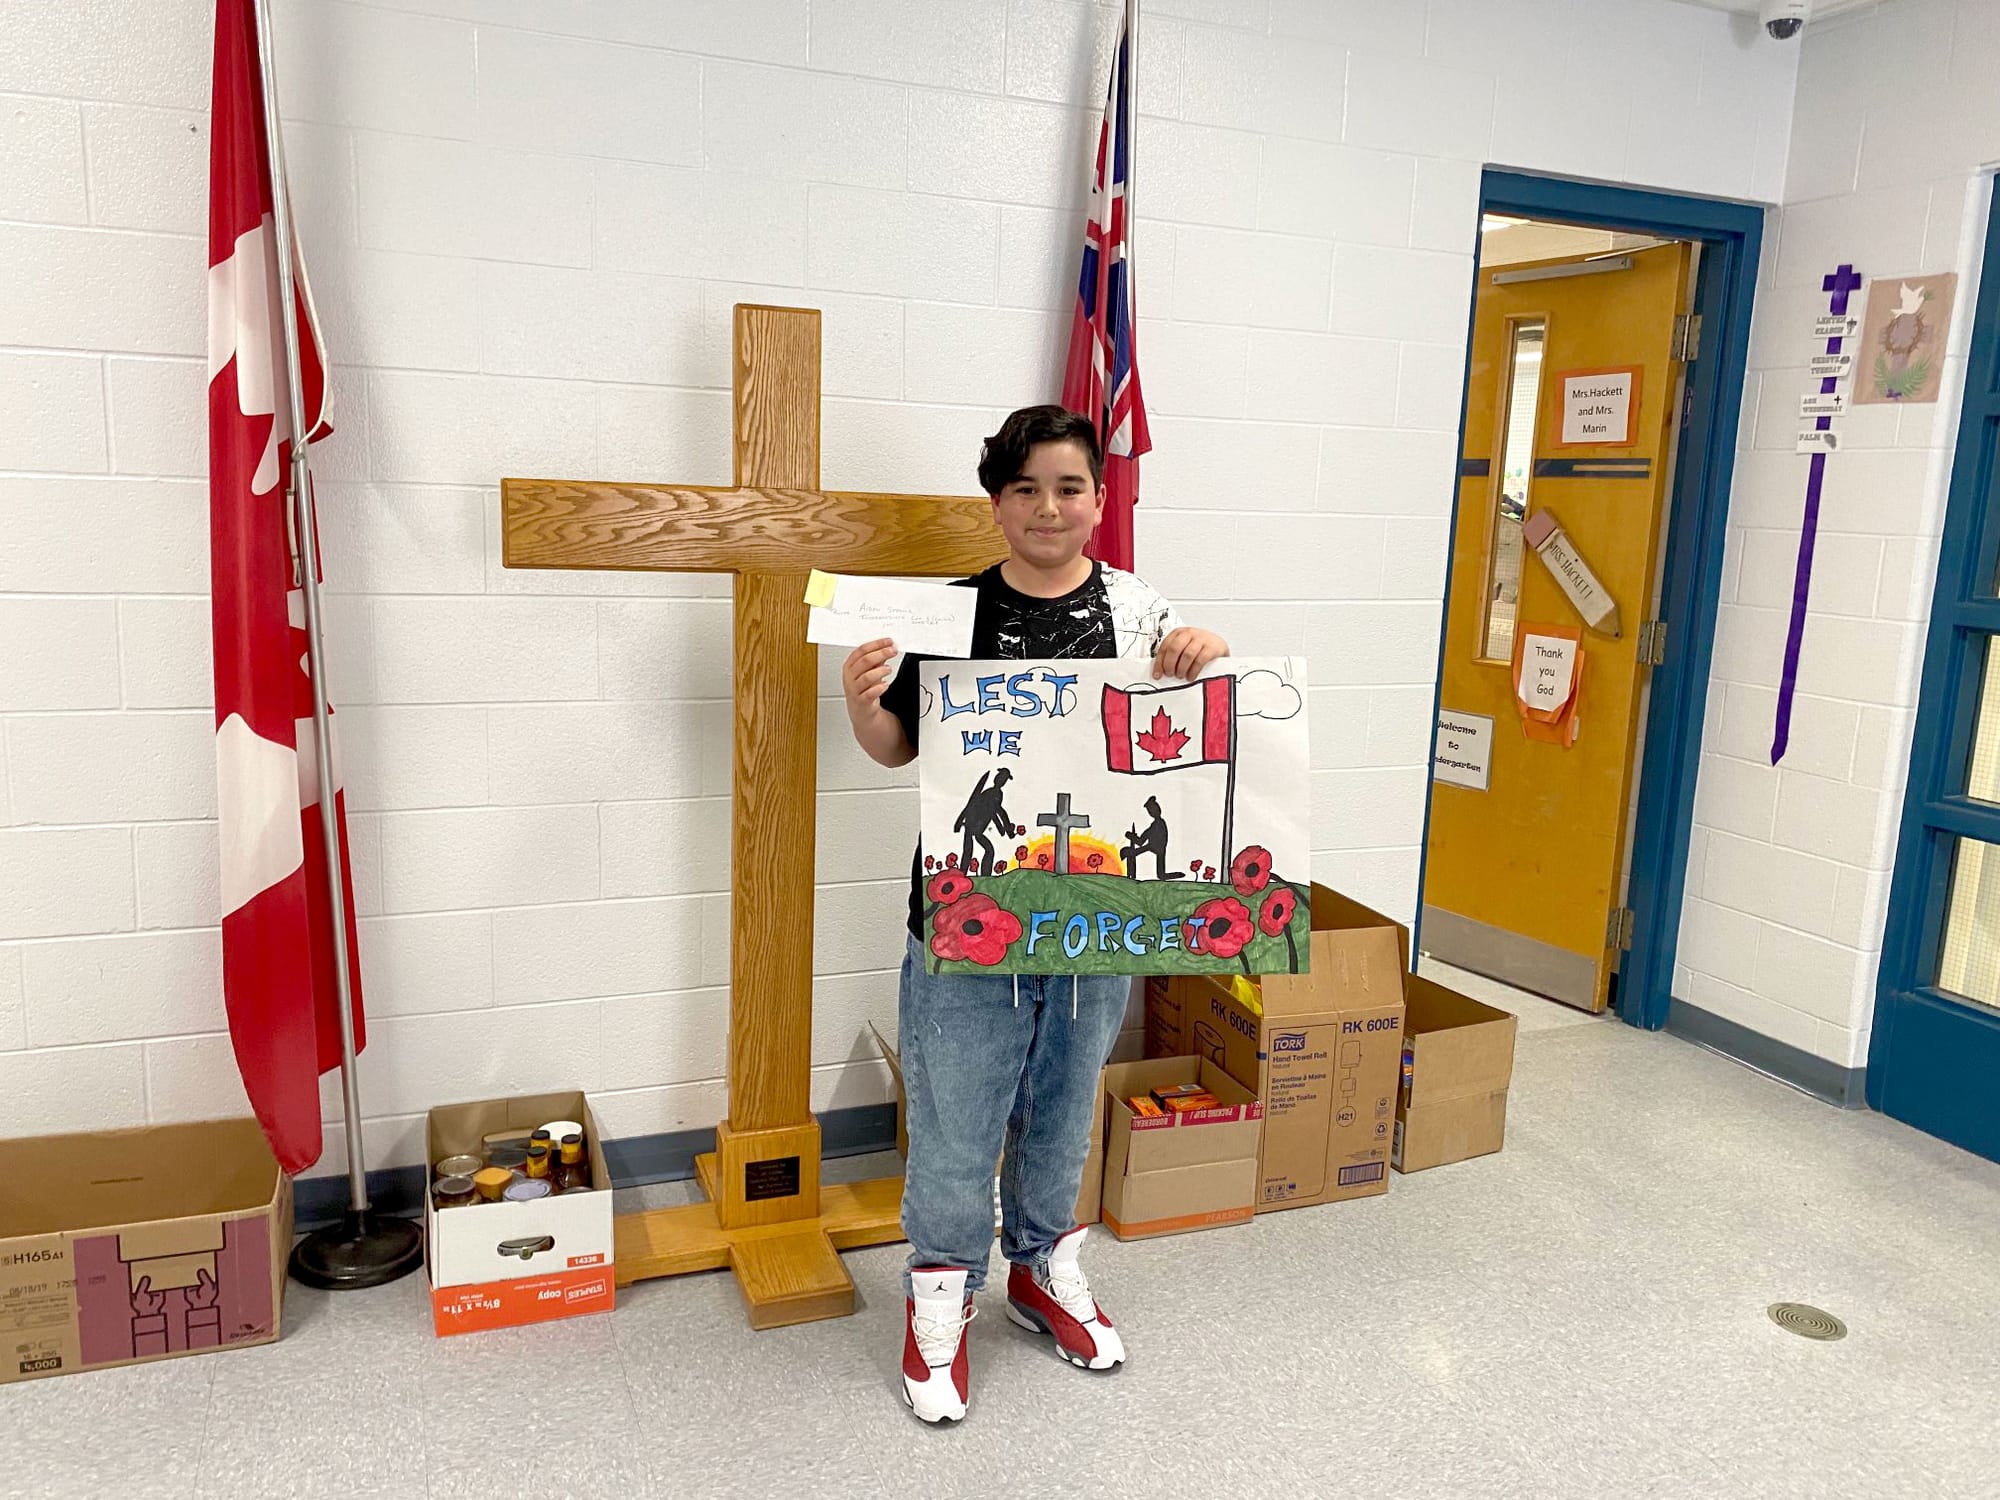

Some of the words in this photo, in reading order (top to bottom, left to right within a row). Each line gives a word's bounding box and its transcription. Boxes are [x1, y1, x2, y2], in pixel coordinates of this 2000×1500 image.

[1577, 405, 1594, 416] and
[1595, 405, 1614, 415] Mrs.
[1582, 424, 1607, 433] Marin
[1560, 559, 1593, 600] HACKETT
[1535, 646, 1563, 659] Thank
[1539, 667, 1556, 678] you
[1536, 683, 1555, 696] God
[939, 673, 1078, 722] LEST
[961, 729, 1022, 757] WE
[1448, 741, 1460, 750] to
[1026, 909, 1207, 958] FORGET
[1210, 998, 1227, 1022] RK
[1229, 1011, 1257, 1041] 600E
[1342, 1020, 1363, 1034] RK
[1366, 1017, 1399, 1032] 600E
[1274, 1038, 1305, 1051] TORK
[1272, 1055, 1291, 1063] Hand
[1292, 1052, 1313, 1062] Towel
[1338, 1112, 1353, 1121] H21
[537, 1289, 562, 1301] copy
[568, 1284, 603, 1300] STAPLES
